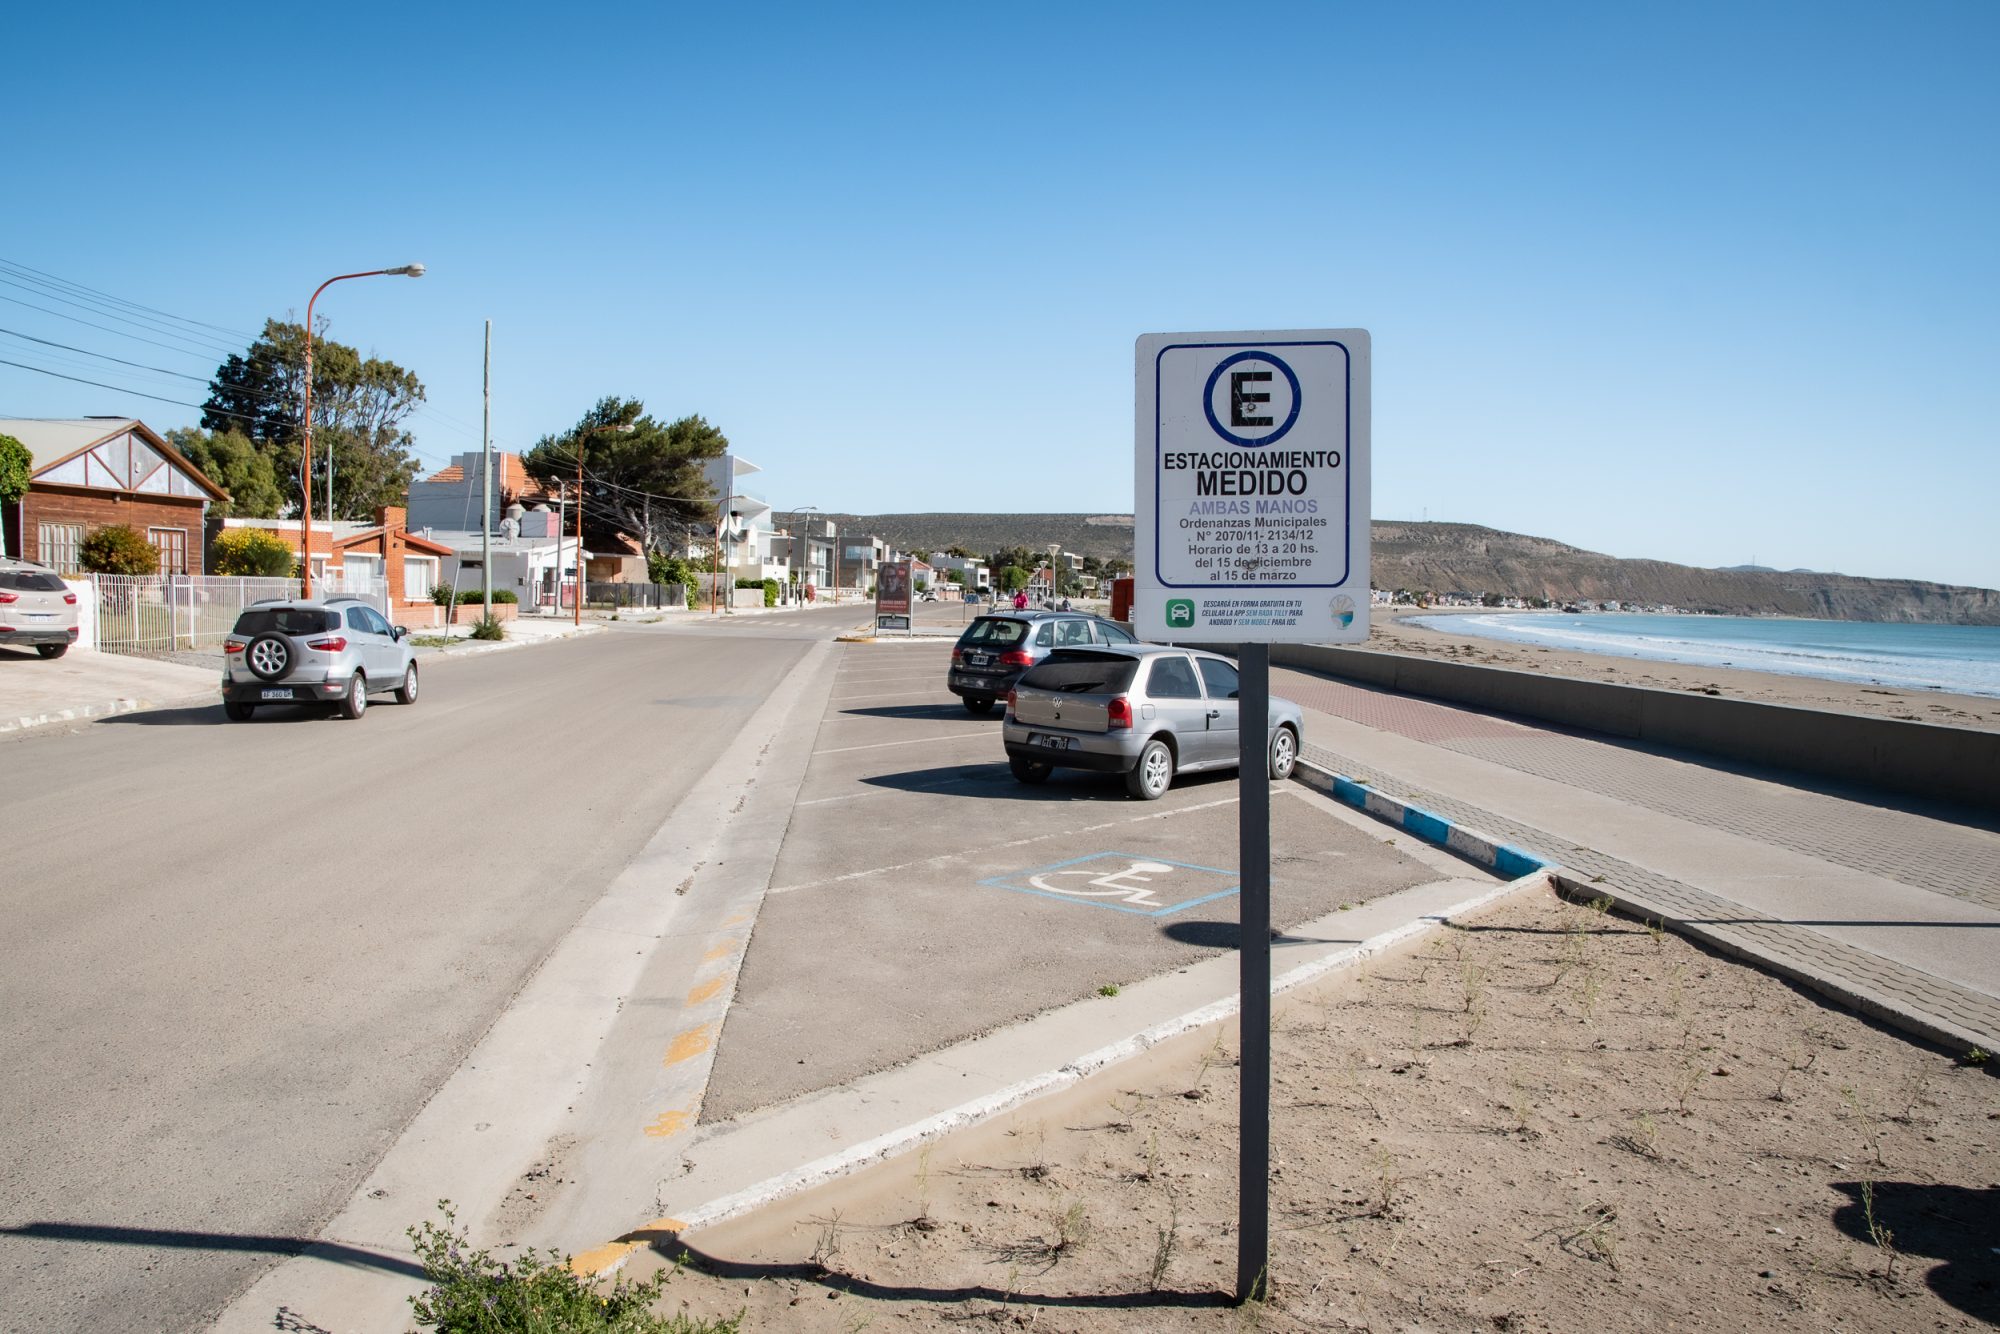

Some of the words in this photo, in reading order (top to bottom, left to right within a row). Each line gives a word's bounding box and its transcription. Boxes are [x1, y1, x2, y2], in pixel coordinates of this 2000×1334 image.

[1230, 371, 1274, 427] E
[1163, 450, 1341, 470] ESTACIONAMIENTO
[1196, 470, 1307, 496] MEDIDO
[1189, 500, 1250, 515] AMBAS
[1256, 499, 1318, 514] MANOS
[1179, 518, 1251, 529] Ordenanzas
[1254, 517, 1327, 530] Municipales
[1267, 530, 1313, 541] 2134/12
[1188, 544, 1233, 555] Horario
[1236, 544, 1250, 554] de
[1255, 544, 1268, 554] 13
[1282, 544, 1297, 554] 20
[1300, 543, 1318, 553] hs.
[1195, 558, 1213, 568] del
[1217, 557, 1231, 567] 15
[1234, 557, 1249, 567] de
[1254, 557, 1312, 567] diciembre
[1210, 571, 1222, 581] al
[1225, 571, 1238, 581] 15
[1241, 571, 1256, 580] de
[1259, 572, 1297, 580] marzo
[1203, 599, 1231, 608] DESCARGÁ
